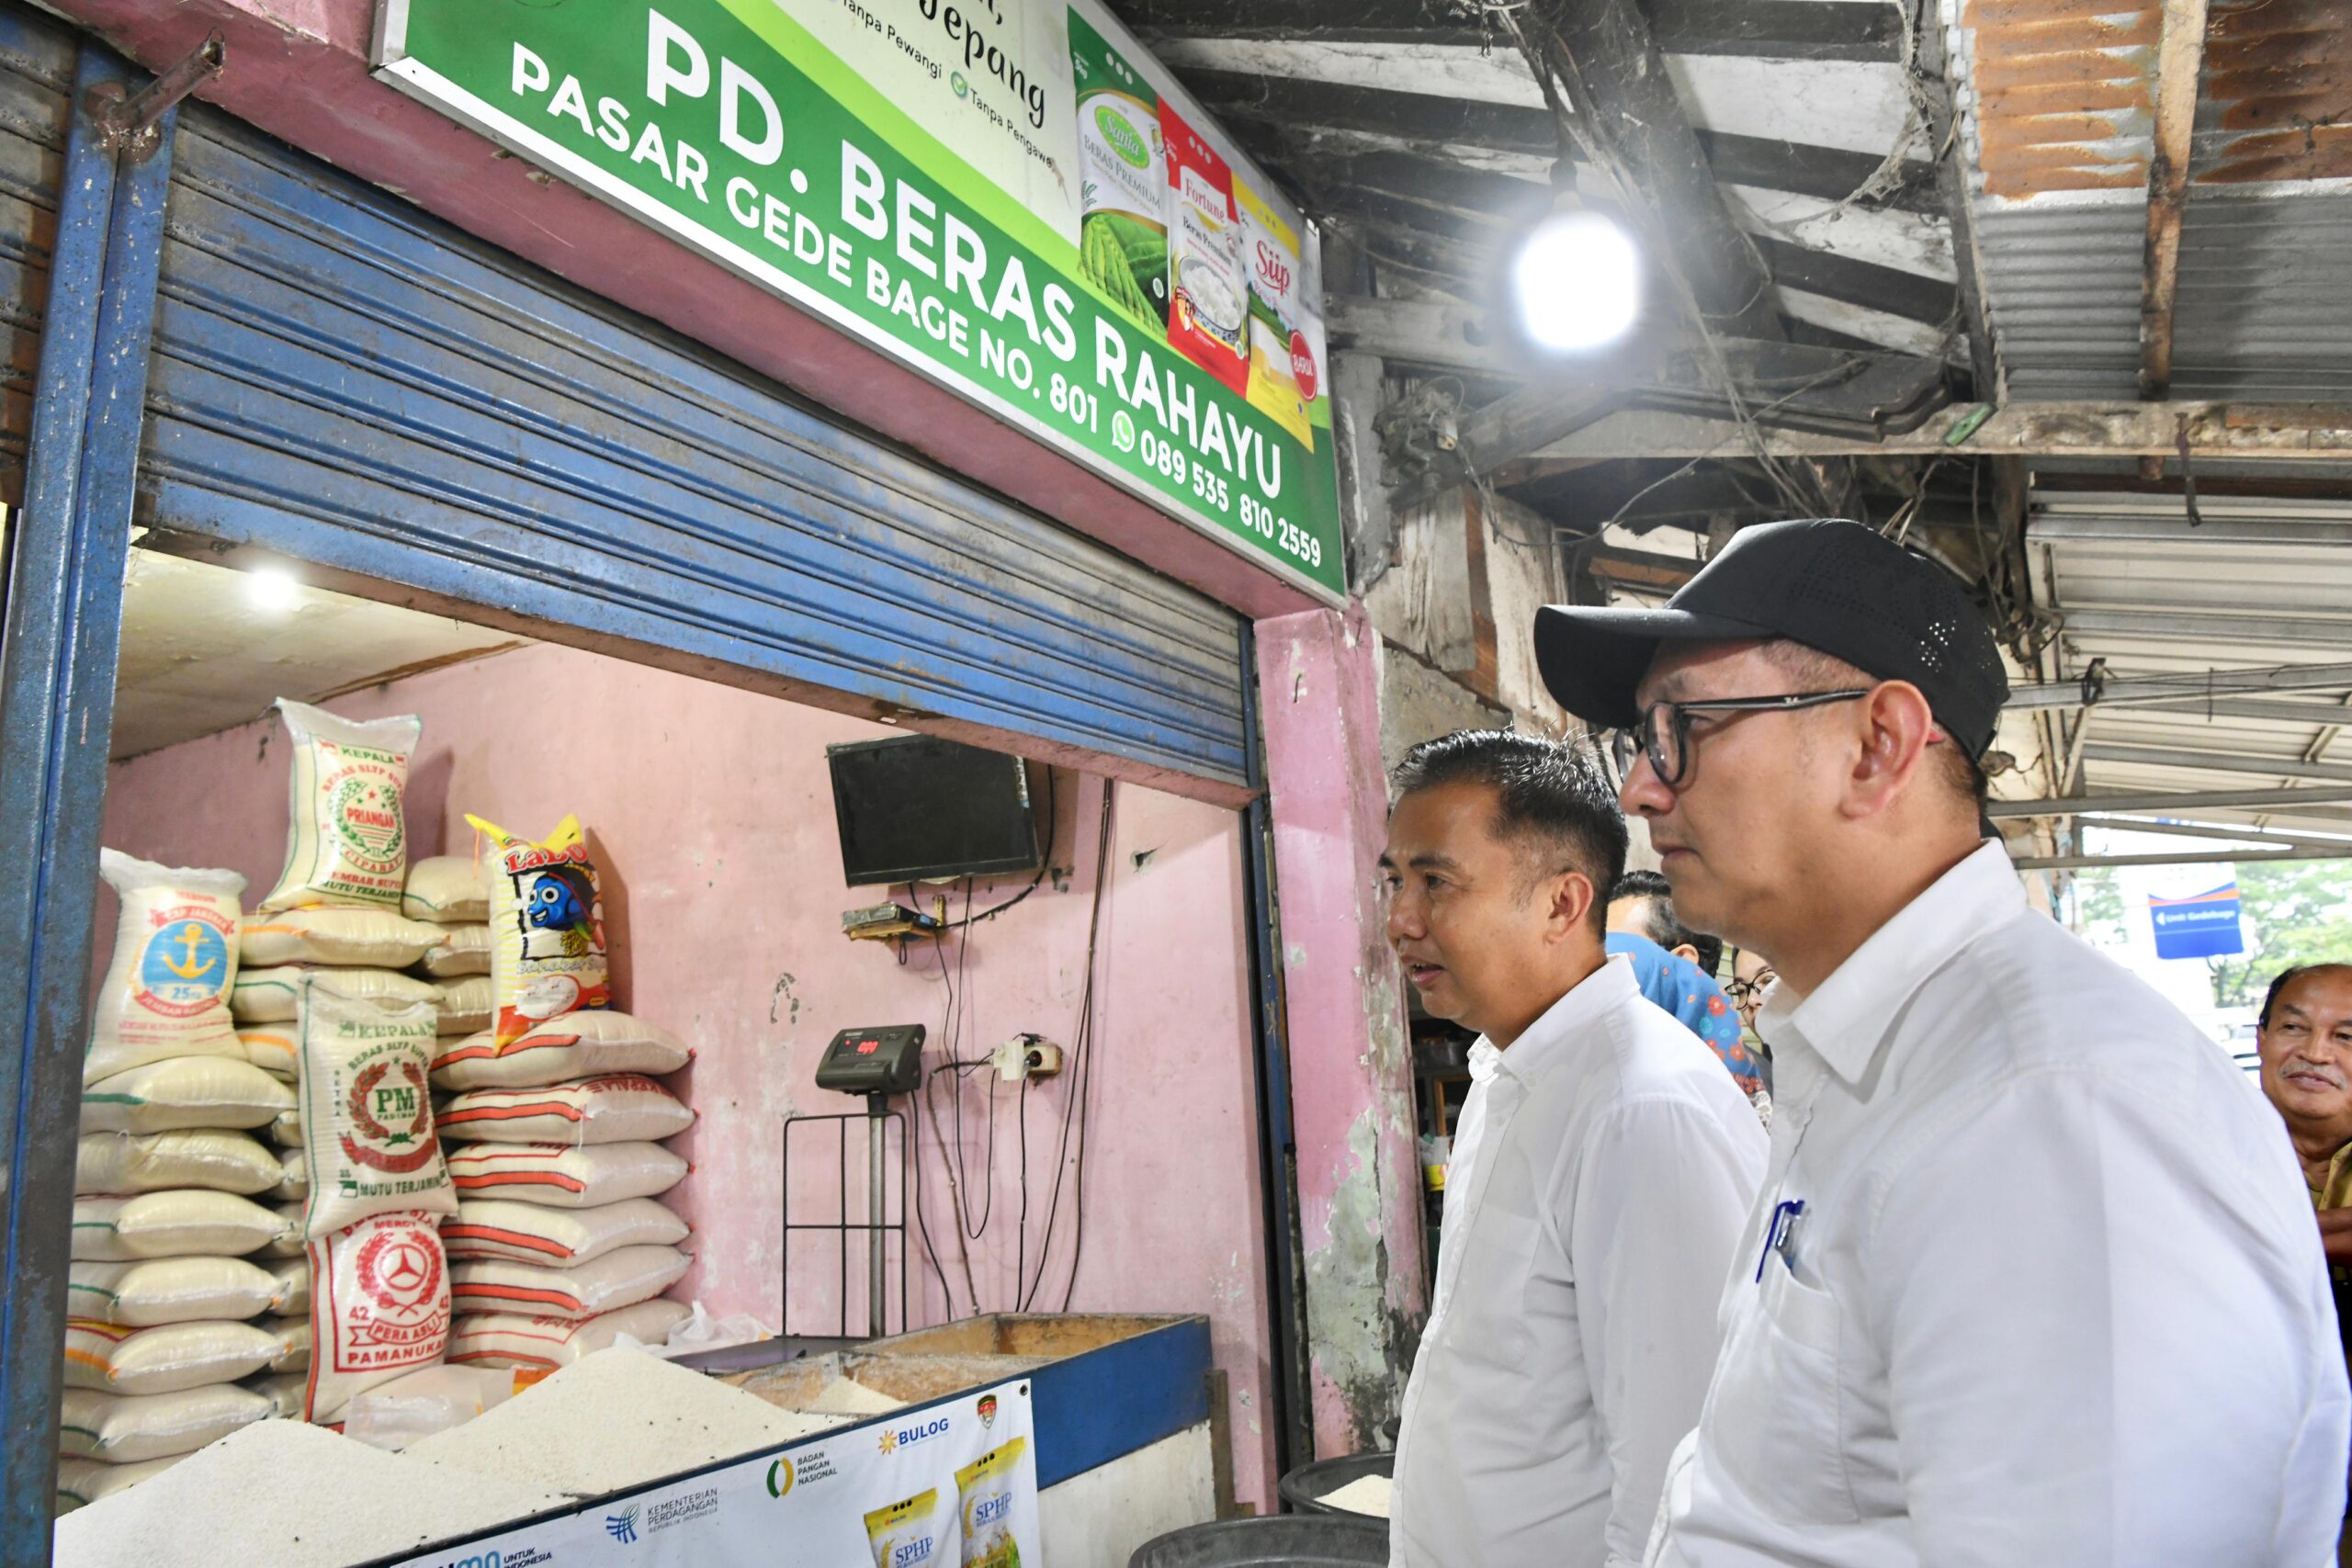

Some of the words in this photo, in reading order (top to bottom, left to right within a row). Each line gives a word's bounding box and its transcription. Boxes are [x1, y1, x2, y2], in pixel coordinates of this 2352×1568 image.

[888, 24, 943, 79] Pewangi
[969, 88, 1004, 127] Tanpa
[1007, 118, 1053, 169] Pengawe
[1105, 116, 1140, 157] Sania
[1083, 134, 1114, 171] BERAS
[1115, 162, 1161, 210] PREMIUM
[1185, 177, 1225, 223] Fortune
[646, 7, 808, 194] PD.
[842, 139, 1077, 362] BERAS
[1095, 315, 1282, 498] RAHAYU
[512, 41, 709, 204] PASAR
[726, 176, 853, 288] GEDE
[866, 256, 968, 357] BAGE
[980, 327, 1040, 399] NO.
[1050, 373, 1098, 433] 801
[1139, 430, 1186, 486] 089
[1192, 468, 1229, 513] 535
[1239, 502, 1273, 539] 810
[1278, 517, 1321, 568] 2559
[341, 747, 395, 764] KEPALA
[322, 765, 356, 792] BERAS
[357, 763, 386, 775] SLYP
[346, 807, 397, 829] PRIANGAN
[171, 986, 191, 1000] 25
[357, 1022, 427, 1039] KEPALA
[347, 1045, 383, 1070] BERAS
[386, 1041, 410, 1052] SLYP
[375, 1087, 416, 1113] PM
[359, 1181, 393, 1196] MUTU
[373, 1219, 416, 1231] MERCY
[349, 1305, 369, 1321] 42
[438, 1293, 450, 1310] 42
[374, 1324, 410, 1342] PERA
[412, 1318, 438, 1337] ASLI
[347, 1339, 445, 1365] PAMANUKA
[898, 1417, 949, 1446] BULOG
[797, 1450, 825, 1467] BADAN
[797, 1459, 831, 1476] PANGAN
[797, 1467, 838, 1486] NASIONAL
[647, 1486, 718, 1517] KEMENTERIAN
[647, 1495, 718, 1527] PERDAGANGAN
[976, 1491, 1012, 1521] SPHP
[649, 1518, 681, 1534] REPUBLIK
[503, 1547, 536, 1563] UNTUK
[503, 1551, 553, 1568] INDONESIA
[895, 1535, 933, 1565] SPHP
